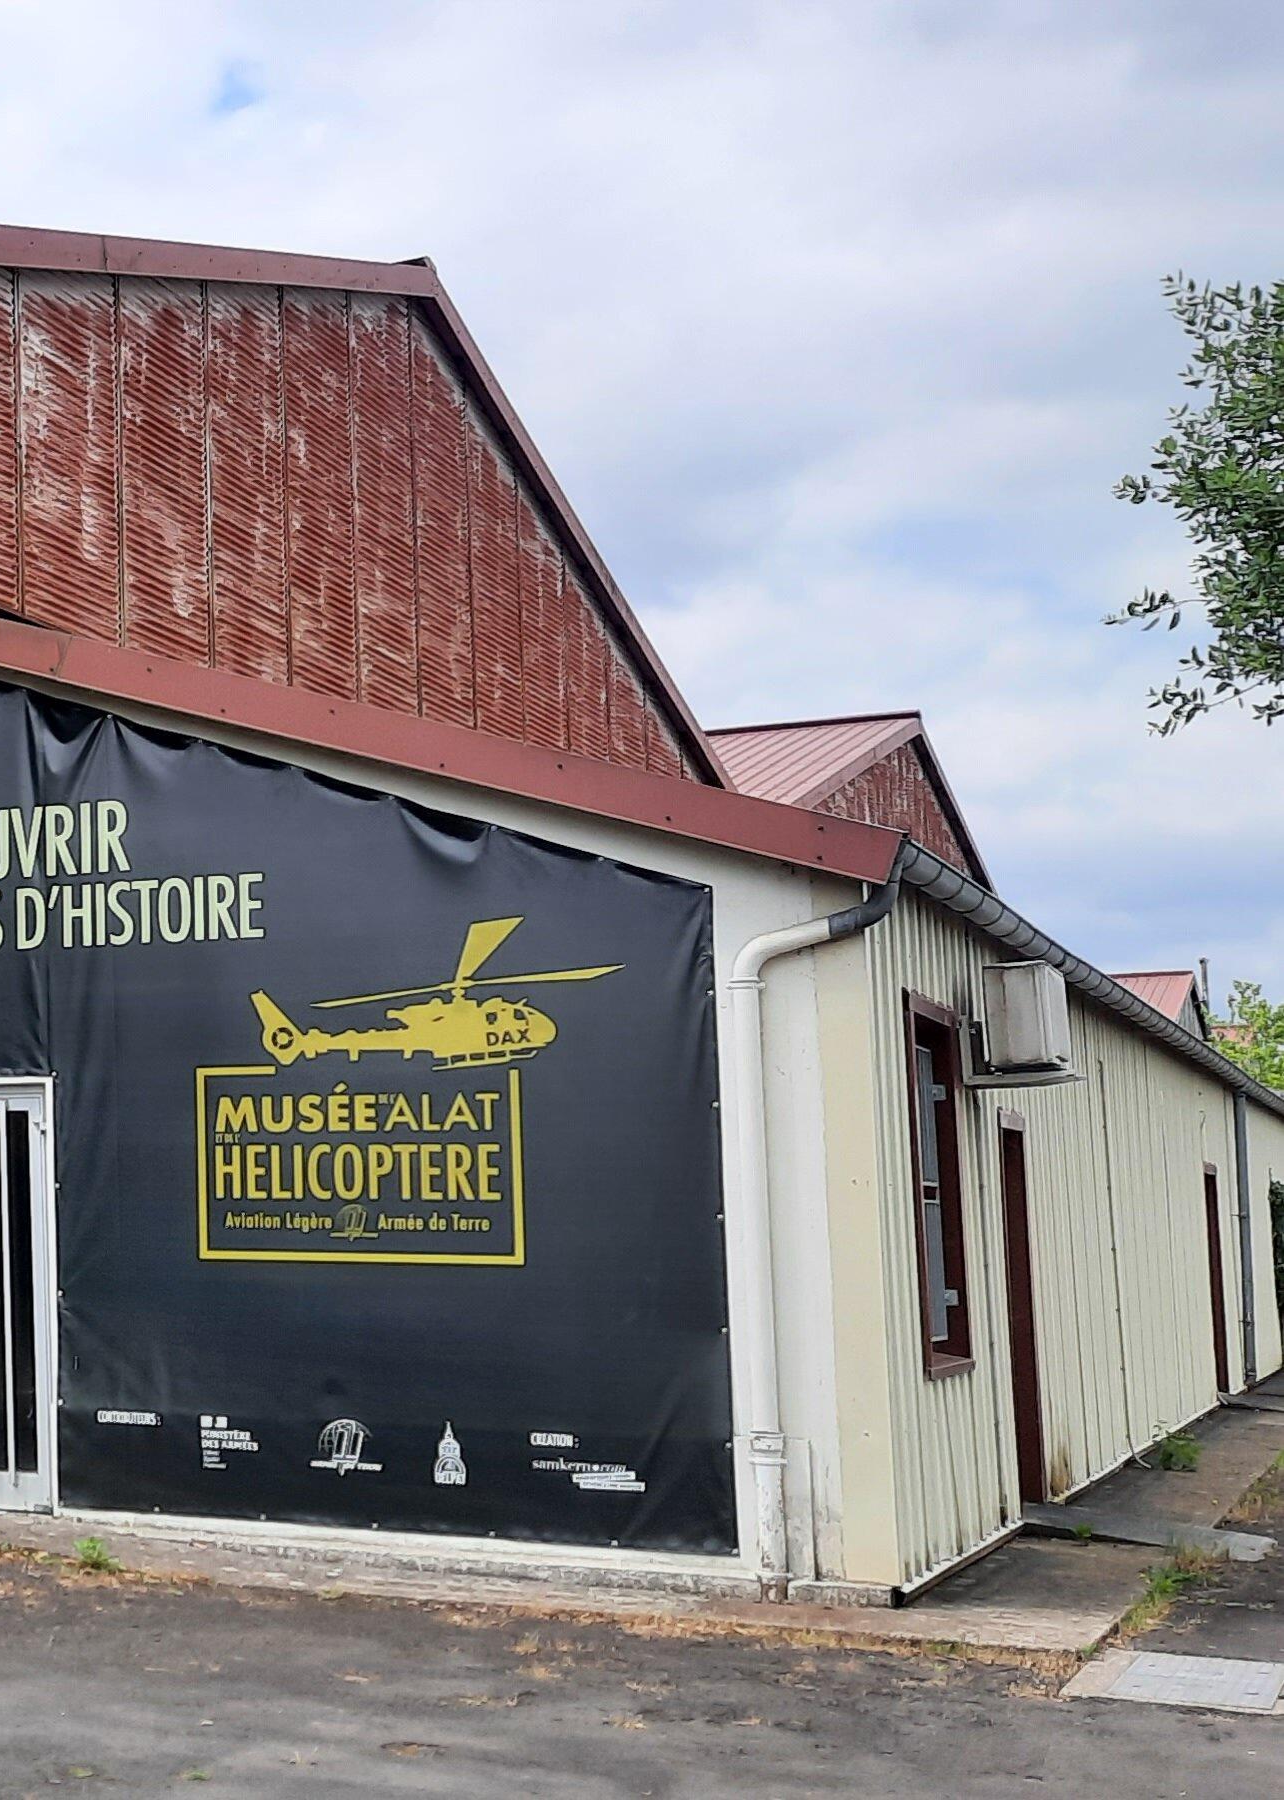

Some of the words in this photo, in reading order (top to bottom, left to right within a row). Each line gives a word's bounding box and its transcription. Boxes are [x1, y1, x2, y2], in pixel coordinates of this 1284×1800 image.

[16, 873, 266, 950] D'HISTOIRE
[486, 1028, 531, 1046] DAX
[215, 1082, 378, 1134] MUSÉE
[384, 1092, 501, 1132] ALAT
[214, 1143, 503, 1201] HELICOPTERE
[225, 1212, 281, 1230] Aviation
[285, 1212, 333, 1233] Légère
[378, 1213, 424, 1231] Armée
[429, 1212, 447, 1231] de
[451, 1213, 491, 1232] Terre
